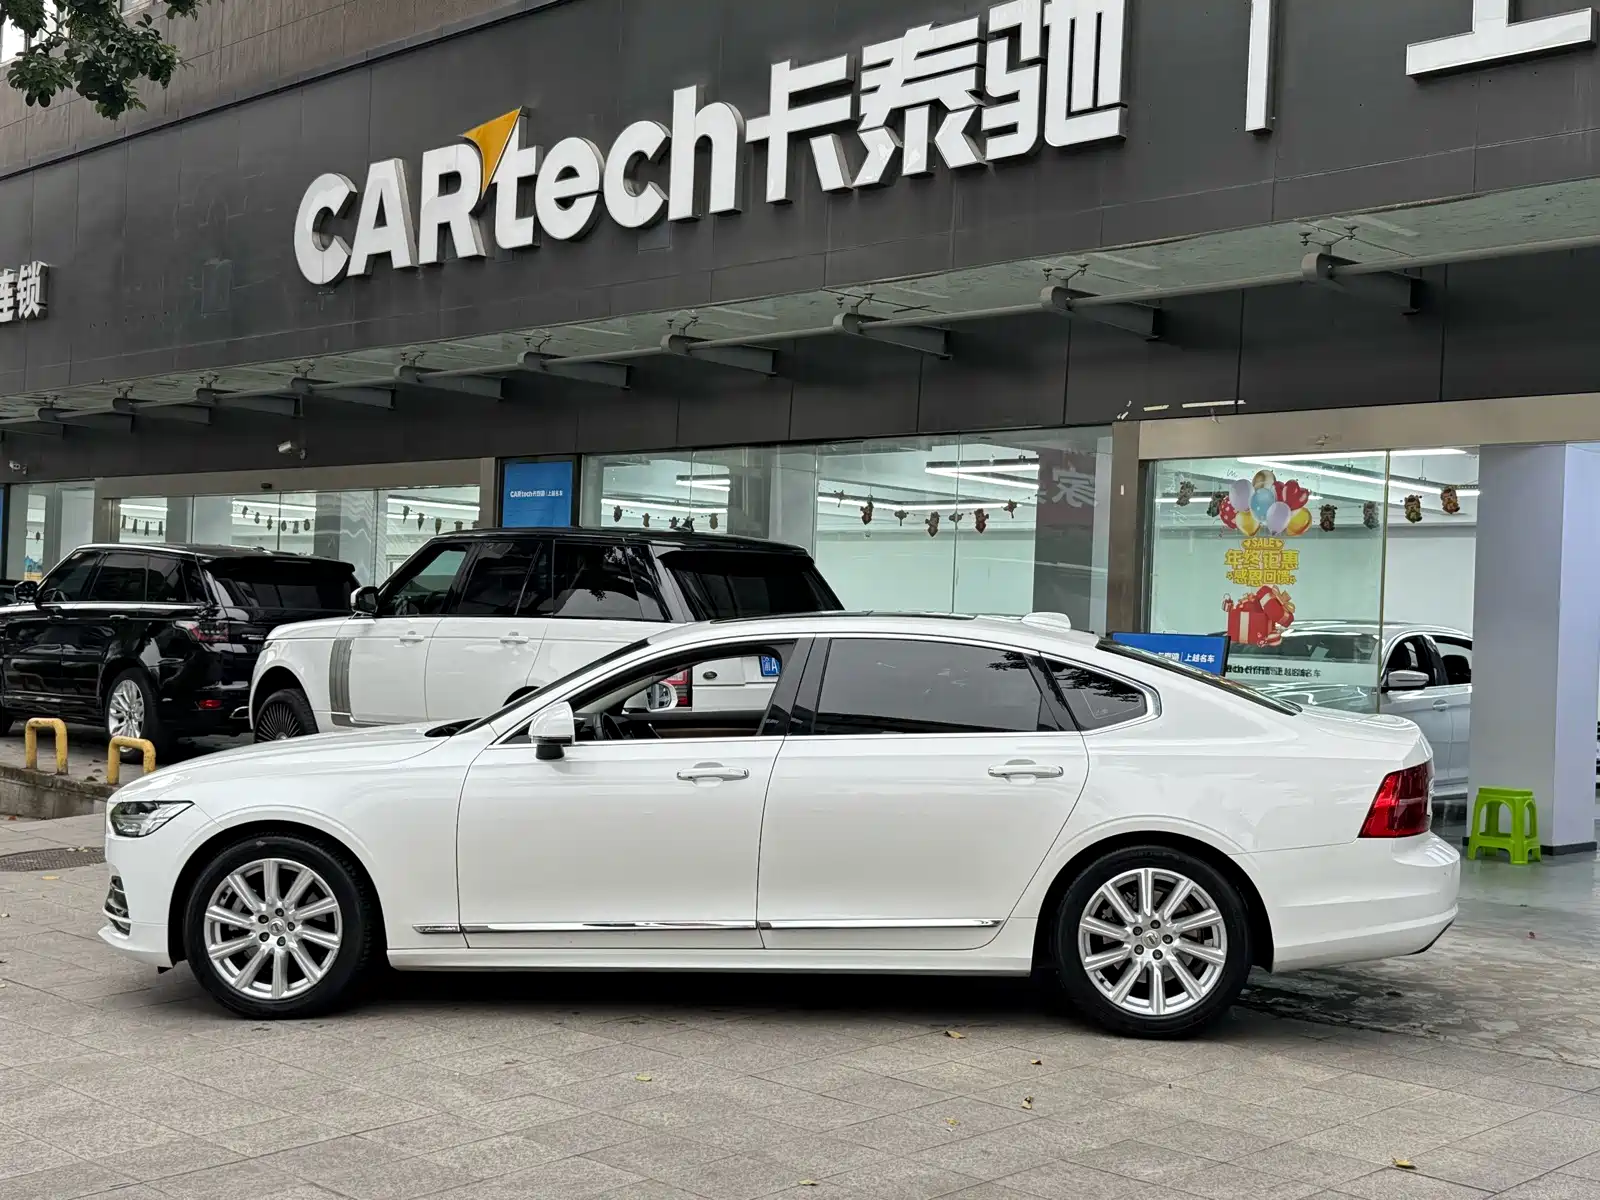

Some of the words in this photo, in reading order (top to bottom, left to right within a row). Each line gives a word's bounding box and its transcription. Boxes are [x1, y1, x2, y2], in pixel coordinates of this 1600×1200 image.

[1251, 537, 1275, 548] SALE
[1225, 549, 1298, 569] 年终钜惠
[1234, 568, 1290, 586] 感恩回馈
[1184, 653, 1215, 663] 上越名车
